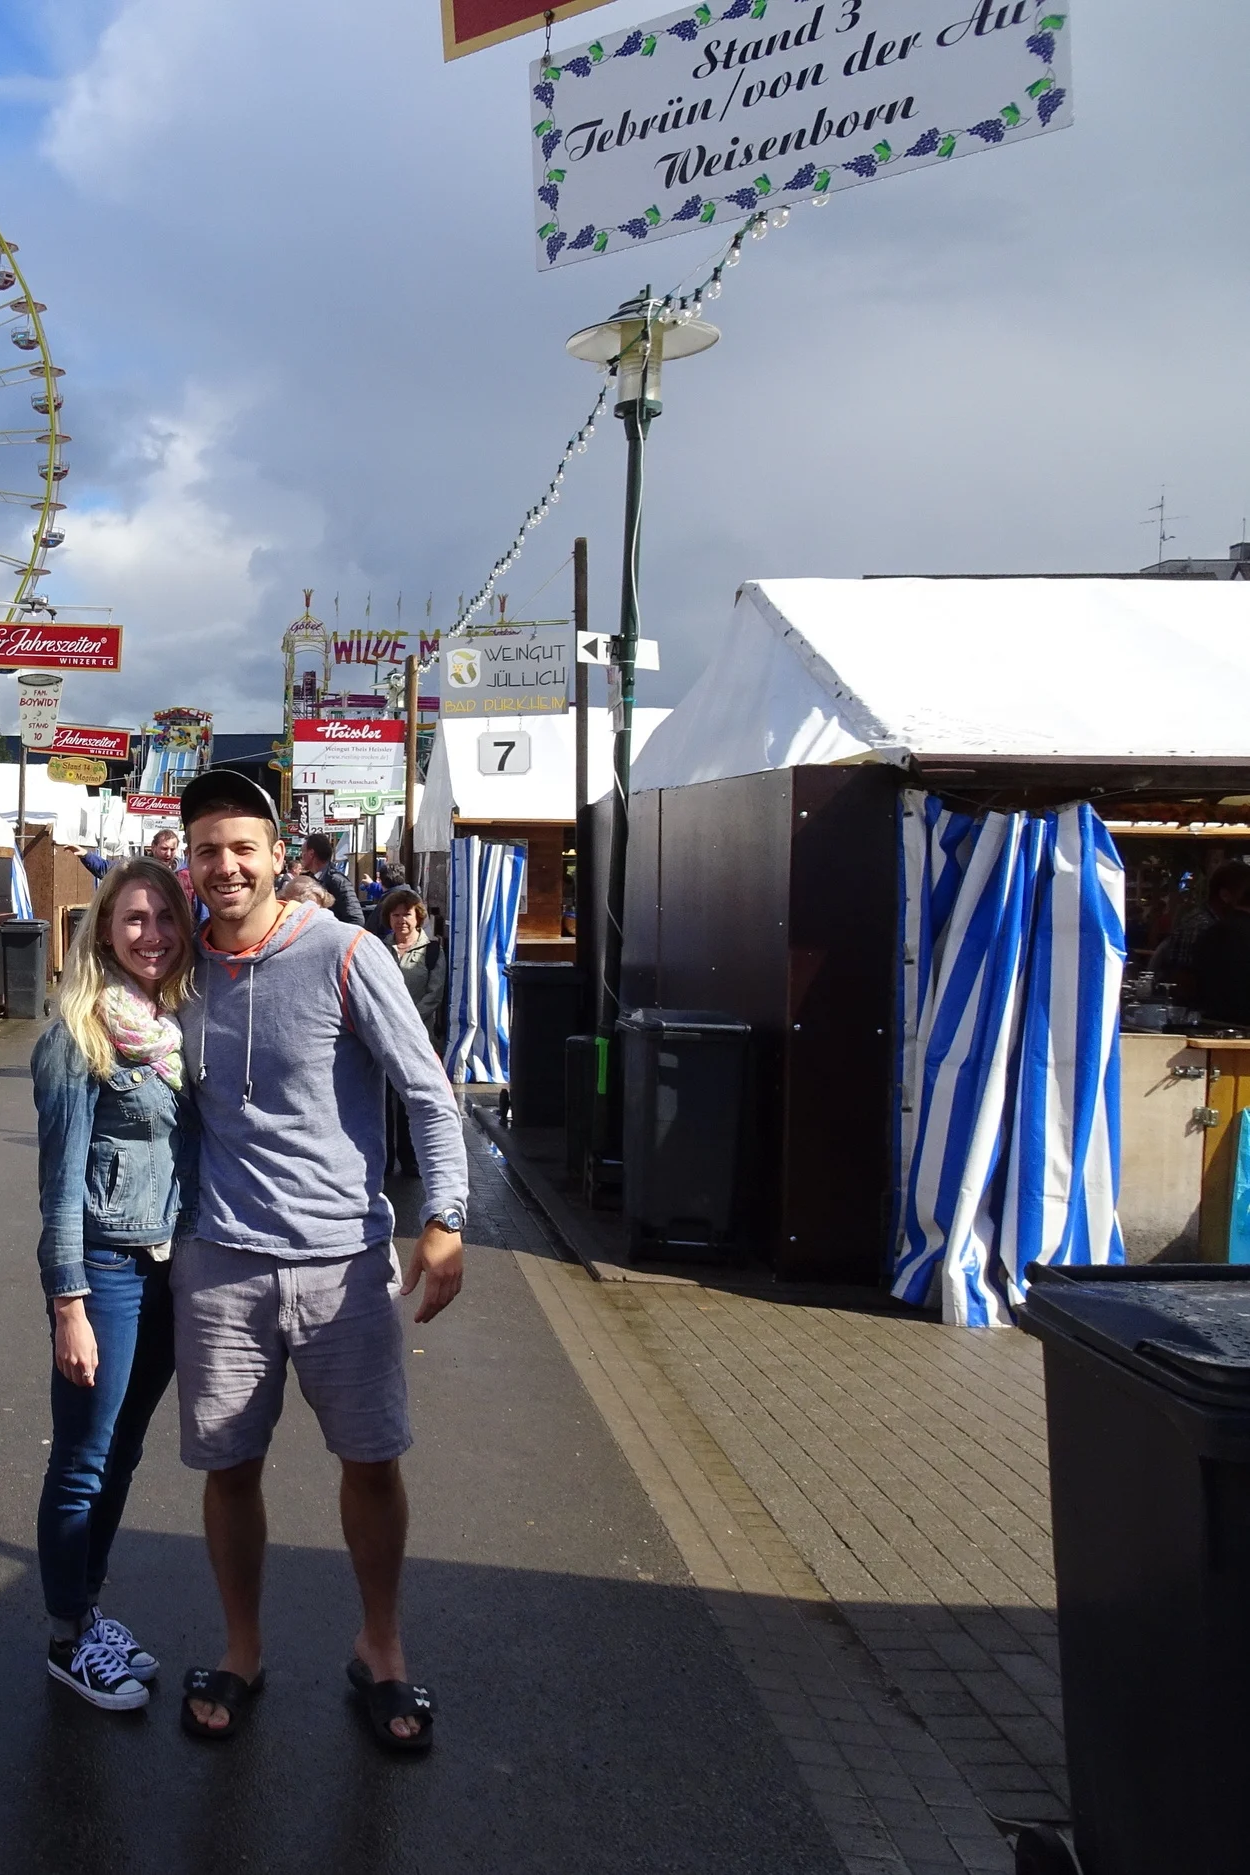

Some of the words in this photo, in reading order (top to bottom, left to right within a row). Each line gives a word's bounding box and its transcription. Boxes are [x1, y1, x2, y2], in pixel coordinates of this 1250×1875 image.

[691, 2, 826, 80] Stand
[835, 0, 862, 33] 3
[842, 30, 923, 77] der
[936, 0, 1033, 47] Au
[653, 95, 920, 188] Weisenborn
[333, 629, 408, 665] WILDE
[484, 644, 566, 662] WEINGUT
[59, 657, 97, 666] WINZER
[444, 700, 476, 713] BAD
[484, 695, 566, 713] DÜRKHEIM
[33, 732, 43, 741] 10
[316, 721, 381, 739] Heissler
[493, 741, 516, 771] 7
[302, 772, 317, 783] 11
